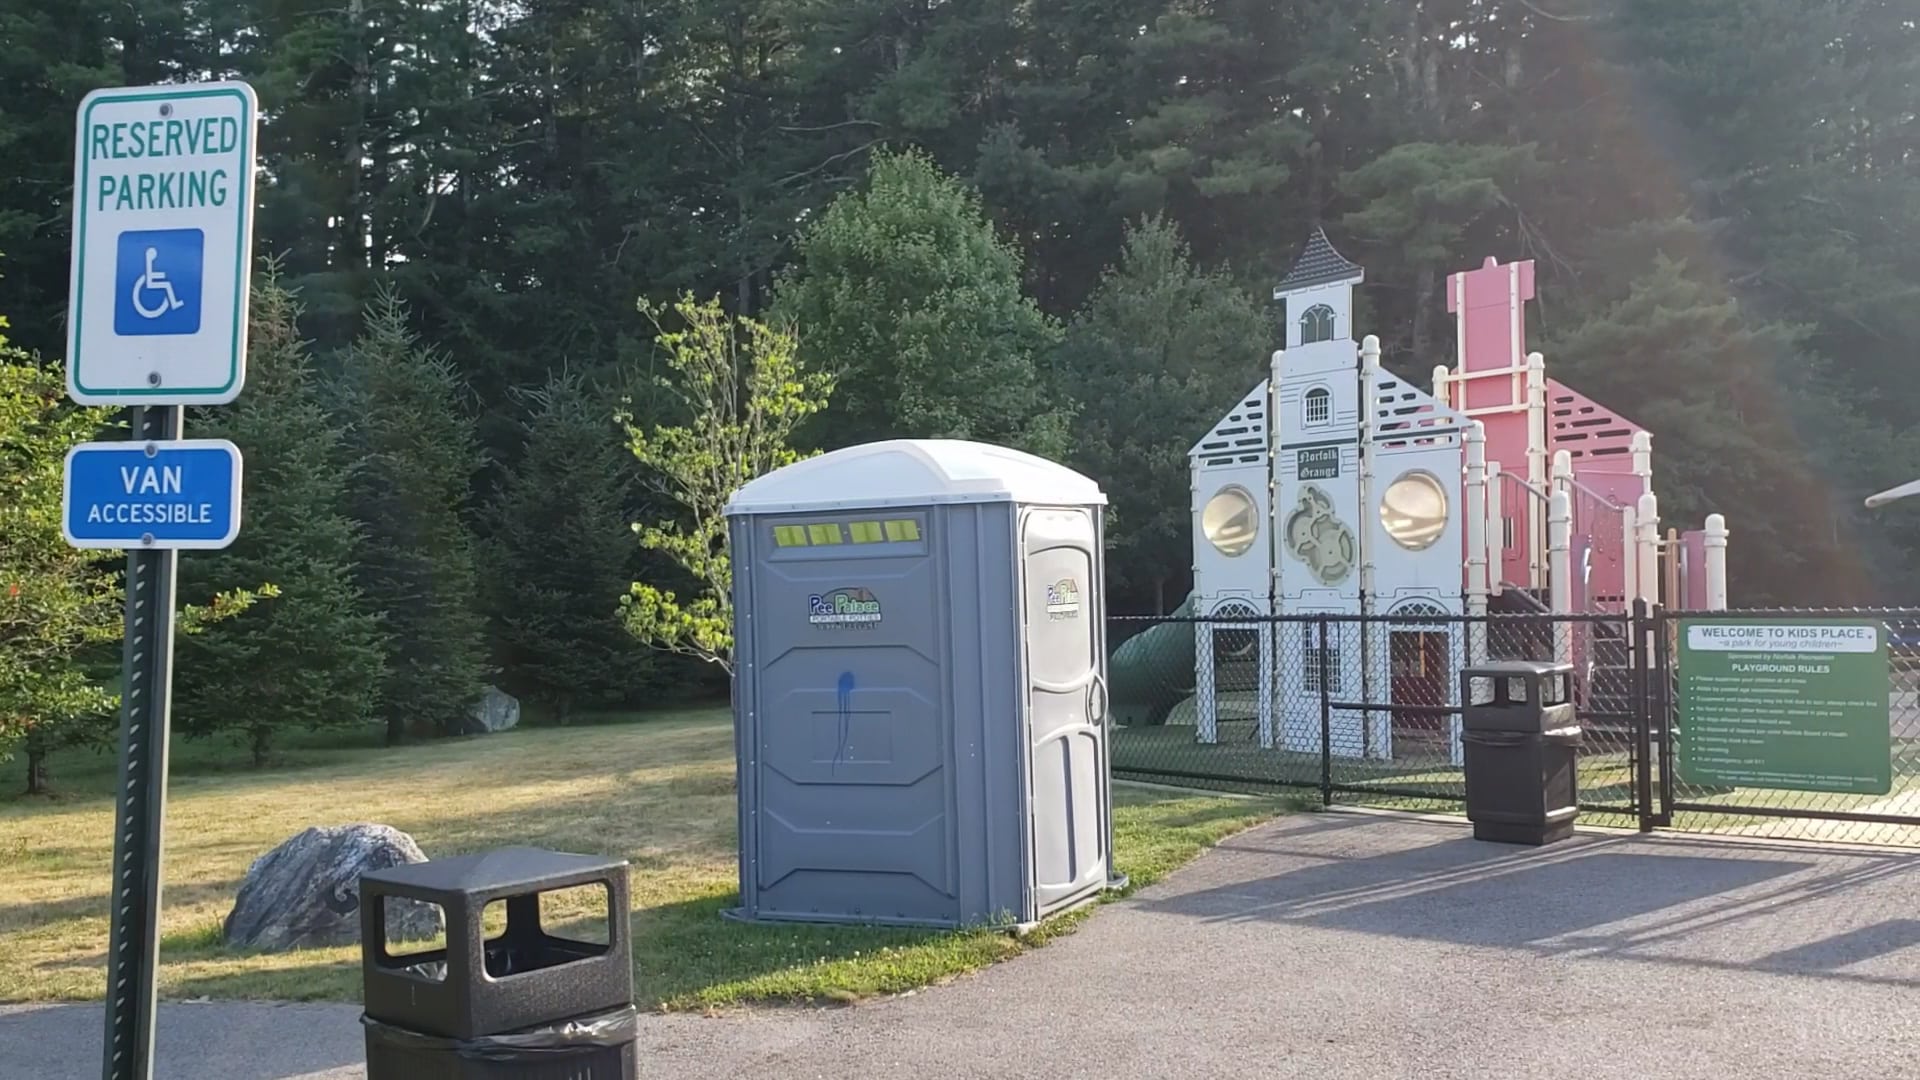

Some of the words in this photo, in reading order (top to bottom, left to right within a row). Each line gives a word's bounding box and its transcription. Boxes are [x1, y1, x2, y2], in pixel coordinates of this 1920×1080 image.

[92, 116, 237, 159] RESERVED
[98, 169, 227, 211] PARKING
[1299, 450, 1337, 463] Norfolk
[120, 465, 182, 494] VAN
[1300, 467, 1336, 478] Grange
[87, 503, 212, 523] ACCESSIBLE
[808, 594, 834, 614] Pee
[835, 594, 879, 613] Palace
[1702, 627, 1763, 638] WELCOME
[1767, 628, 1784, 638] TO
[1788, 628, 1818, 639] KIDS
[1821, 629, 1864, 639] PLACE
[1731, 639, 1752, 649] park
[1754, 639, 1767, 648] for
[1769, 641, 1798, 650] young
[1732, 663, 1796, 673] PLAYGROUND
[1798, 665, 1830, 674] RULES
